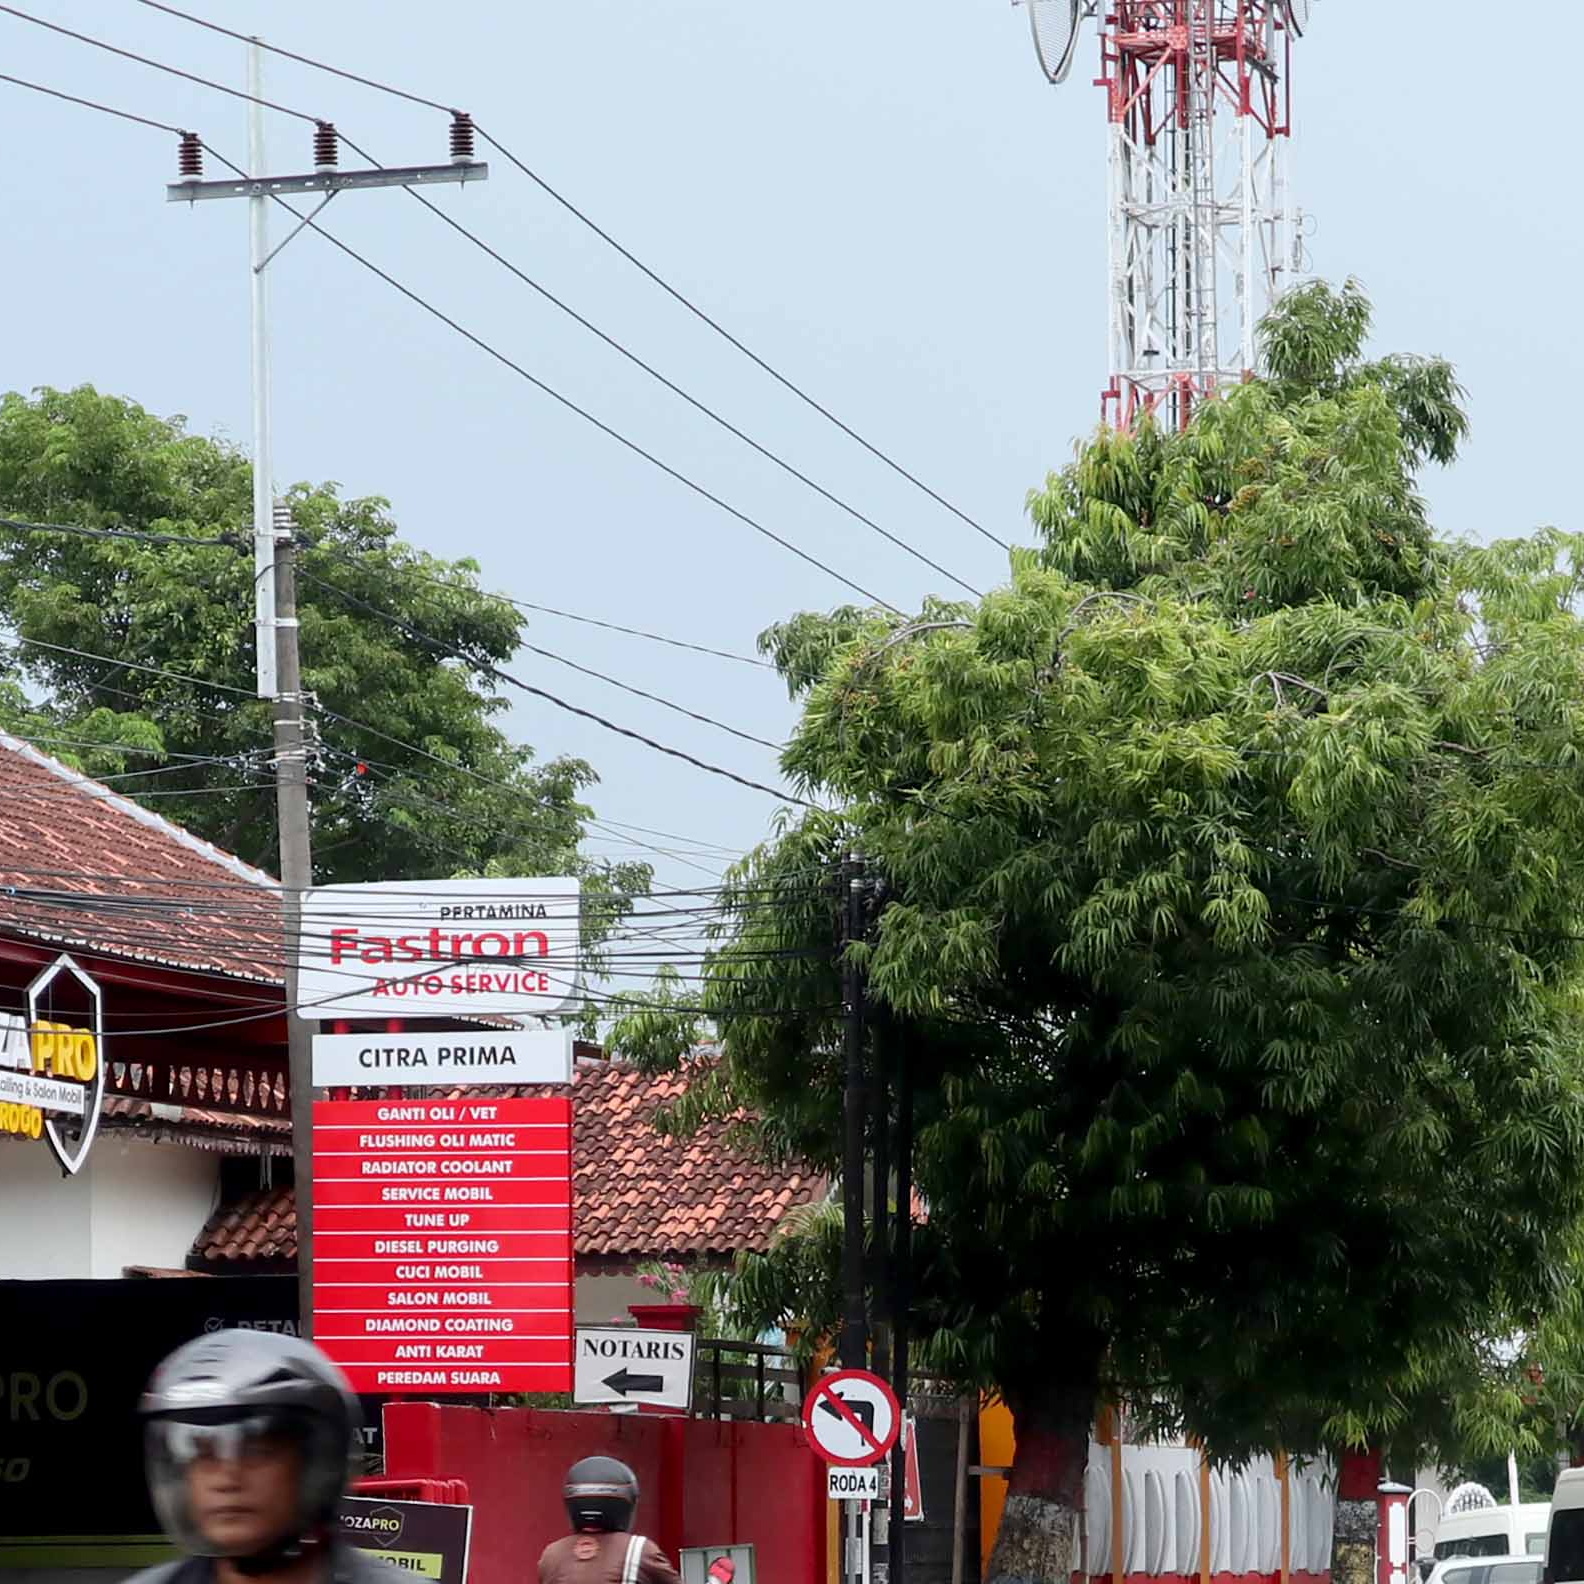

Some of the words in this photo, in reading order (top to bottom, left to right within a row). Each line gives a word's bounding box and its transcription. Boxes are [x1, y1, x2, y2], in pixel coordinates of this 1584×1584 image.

[439, 903, 548, 920] PERTAMINA
[330, 927, 550, 965] Fastron
[372, 974, 444, 997] AUTO
[450, 973, 549, 995] SERVICE
[358, 1048, 428, 1068] CITRA
[437, 1046, 517, 1066] PRIMA
[24, 1082, 32, 1096] &
[33, 1084, 60, 1100] Salon
[59, 1088, 83, 1105] Mobil
[377, 1107, 425, 1121] GANTI
[429, 1107, 455, 1120] OLI
[458, 1107, 465, 1120] /
[469, 1106, 497, 1120] VET
[359, 1134, 435, 1148] FLUSHING
[439, 1134, 465, 1147] OLI
[469, 1133, 515, 1147] MATIC
[361, 1161, 436, 1174] RADIATOR
[440, 1160, 513, 1174] COOLANT
[381, 1188, 440, 1200] SERVICE
[444, 1187, 493, 1200] MOBIL
[404, 1213, 445, 1227] TUNE
[448, 1213, 470, 1226] UP
[375, 1240, 423, 1254] DIESEL
[427, 1240, 499, 1254] PURGING
[395, 1265, 430, 1279] CUCI
[434, 1265, 483, 1278] MOBIL
[387, 1292, 438, 1305] SALON
[442, 1292, 492, 1305] MOBIL
[365, 1318, 440, 1332] DIAMOND
[444, 1318, 514, 1332] COATING
[395, 1345, 431, 1359] ANTI
[435, 1345, 484, 1358] KARAT
[582, 1338, 685, 1360] NOTARIS
[377, 1371, 446, 1385] PEREDAM
[450, 1371, 501, 1385] SUARA
[828, 1474, 866, 1492] RODA
[868, 1473, 877, 1492] 4
[339, 1515, 400, 1532] OZAPRO
